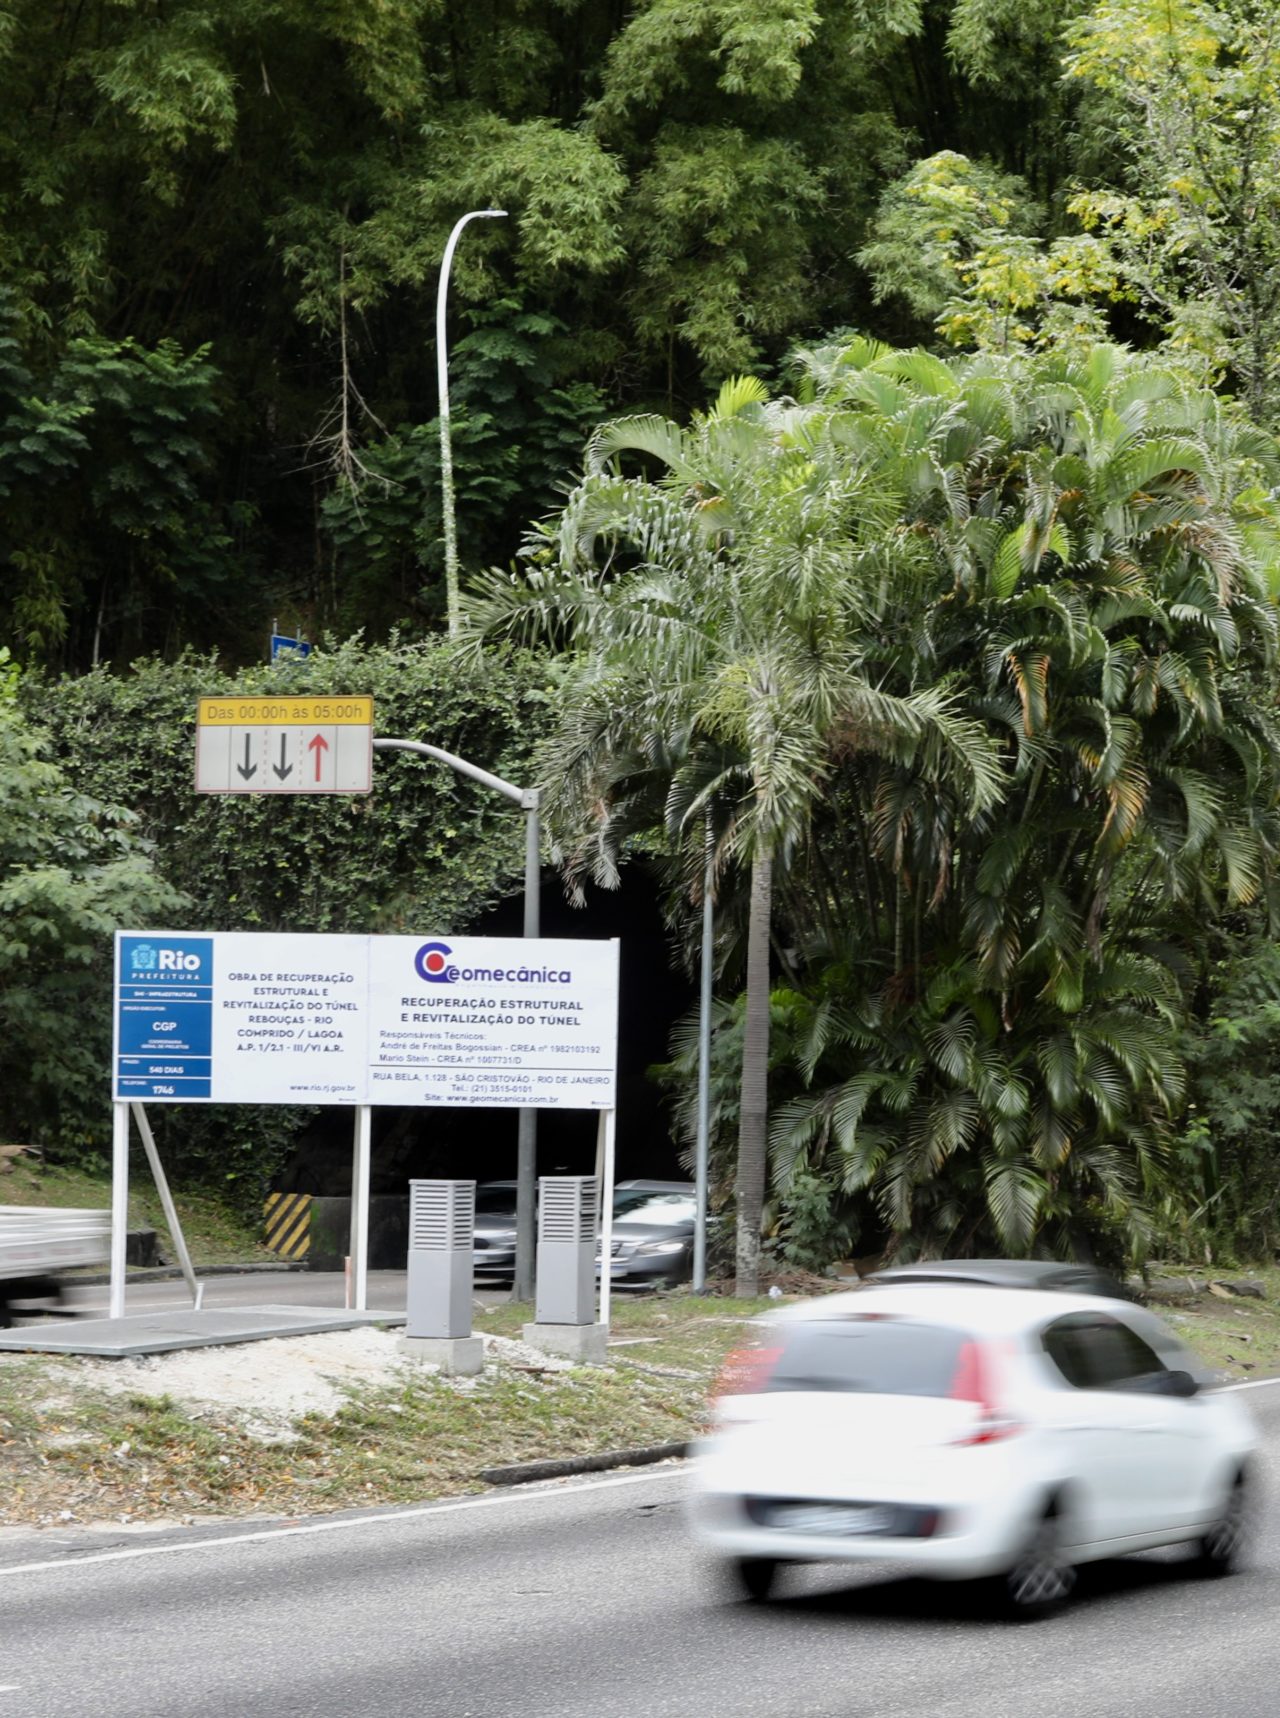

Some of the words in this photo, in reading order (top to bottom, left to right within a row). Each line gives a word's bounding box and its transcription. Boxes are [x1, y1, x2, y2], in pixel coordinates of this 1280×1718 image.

[207, 705, 234, 720] Das
[239, 705, 288, 719] 00:00h
[292, 703, 309, 719] às
[313, 704, 363, 718] 05:00h
[158, 949, 201, 971] Rio
[414, 942, 571, 984] Geomecânica
[131, 972, 200, 980] PREFEITURA
[228, 972, 257, 981] OBRA
[260, 972, 273, 981] DE
[276, 972, 354, 984] RECUPERAÇÃO
[253, 987, 320, 996] ESTRUTURAL
[322, 988, 329, 996] E
[223, 999, 304, 1011] REVITALIZAÇÃO
[307, 1002, 323, 1010] DO
[326, 1000, 358, 1011] TÚNEL
[401, 997, 496, 1010] RECUPERAÇÃO
[500, 1000, 584, 1011] ESTRUTURAL
[248, 1015, 305, 1025] REBOUÇAS
[314, 1016, 333, 1024] RIO
[400, 1013, 409, 1022] E
[412, 1013, 513, 1026] REVITALIZAÇÃO
[517, 1016, 535, 1025] DO
[539, 1014, 581, 1026] TÚNEL
[152, 1021, 177, 1031] CGP
[237, 1029, 295, 1038] COMPRIDO
[297, 1029, 305, 1039] /
[308, 1030, 343, 1039] LAGOA
[379, 1030, 441, 1040] Responsáveis
[380, 1041, 407, 1050] André
[409, 1042, 421, 1050] de
[423, 1042, 453, 1051] Freitas
[510, 1044, 536, 1052] CREA
[436, 1055, 463, 1063] CREA
[164, 1066, 184, 1074] DIAS
[373, 1072, 392, 1080] RUA
[455, 1073, 474, 1082] SÃO
[476, 1073, 530, 1083] CRISTOVÃO
[537, 1075, 554, 1084] RIO
[555, 1076, 569, 1084] DE
[570, 1076, 610, 1085] JANEIRO
[152, 1085, 175, 1095] 1746
